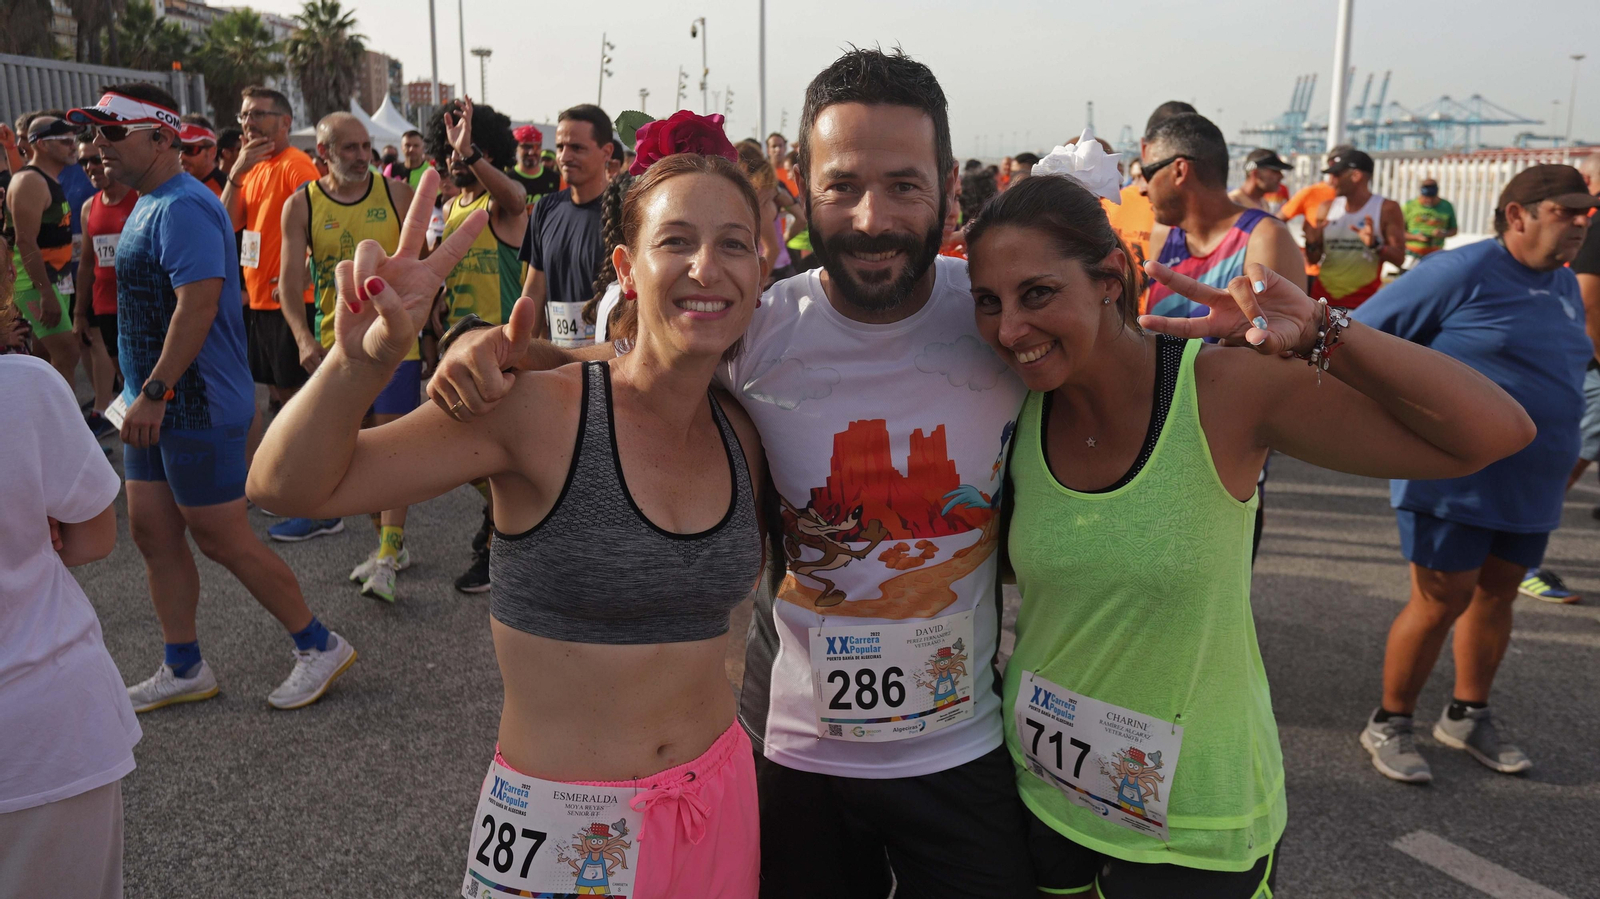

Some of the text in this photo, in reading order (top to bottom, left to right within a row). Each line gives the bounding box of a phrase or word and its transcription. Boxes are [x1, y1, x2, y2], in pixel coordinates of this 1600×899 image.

[97, 245, 115, 257] 179
[556, 318, 578, 335] 894
[915, 624, 944, 637] DAVID
[924, 631, 952, 642] FERNANDEZ
[825, 636, 880, 655] XX Carrera
[850, 645, 882, 654] Popular
[914, 640, 942, 648] VETERANO
[827, 666, 906, 711] 286
[1030, 685, 1076, 712] XX Carrera
[1049, 702, 1075, 721] Popular
[892, 724, 918, 733] Algeciras
[1104, 727, 1134, 740] VETERANO
[1125, 728, 1152, 740] ALCARAZ
[1026, 717, 1091, 780] 717
[490, 775, 529, 800] XX Carrera
[502, 792, 528, 809] Popular
[553, 790, 618, 804] ESMERALDA
[475, 814, 547, 879] 287
